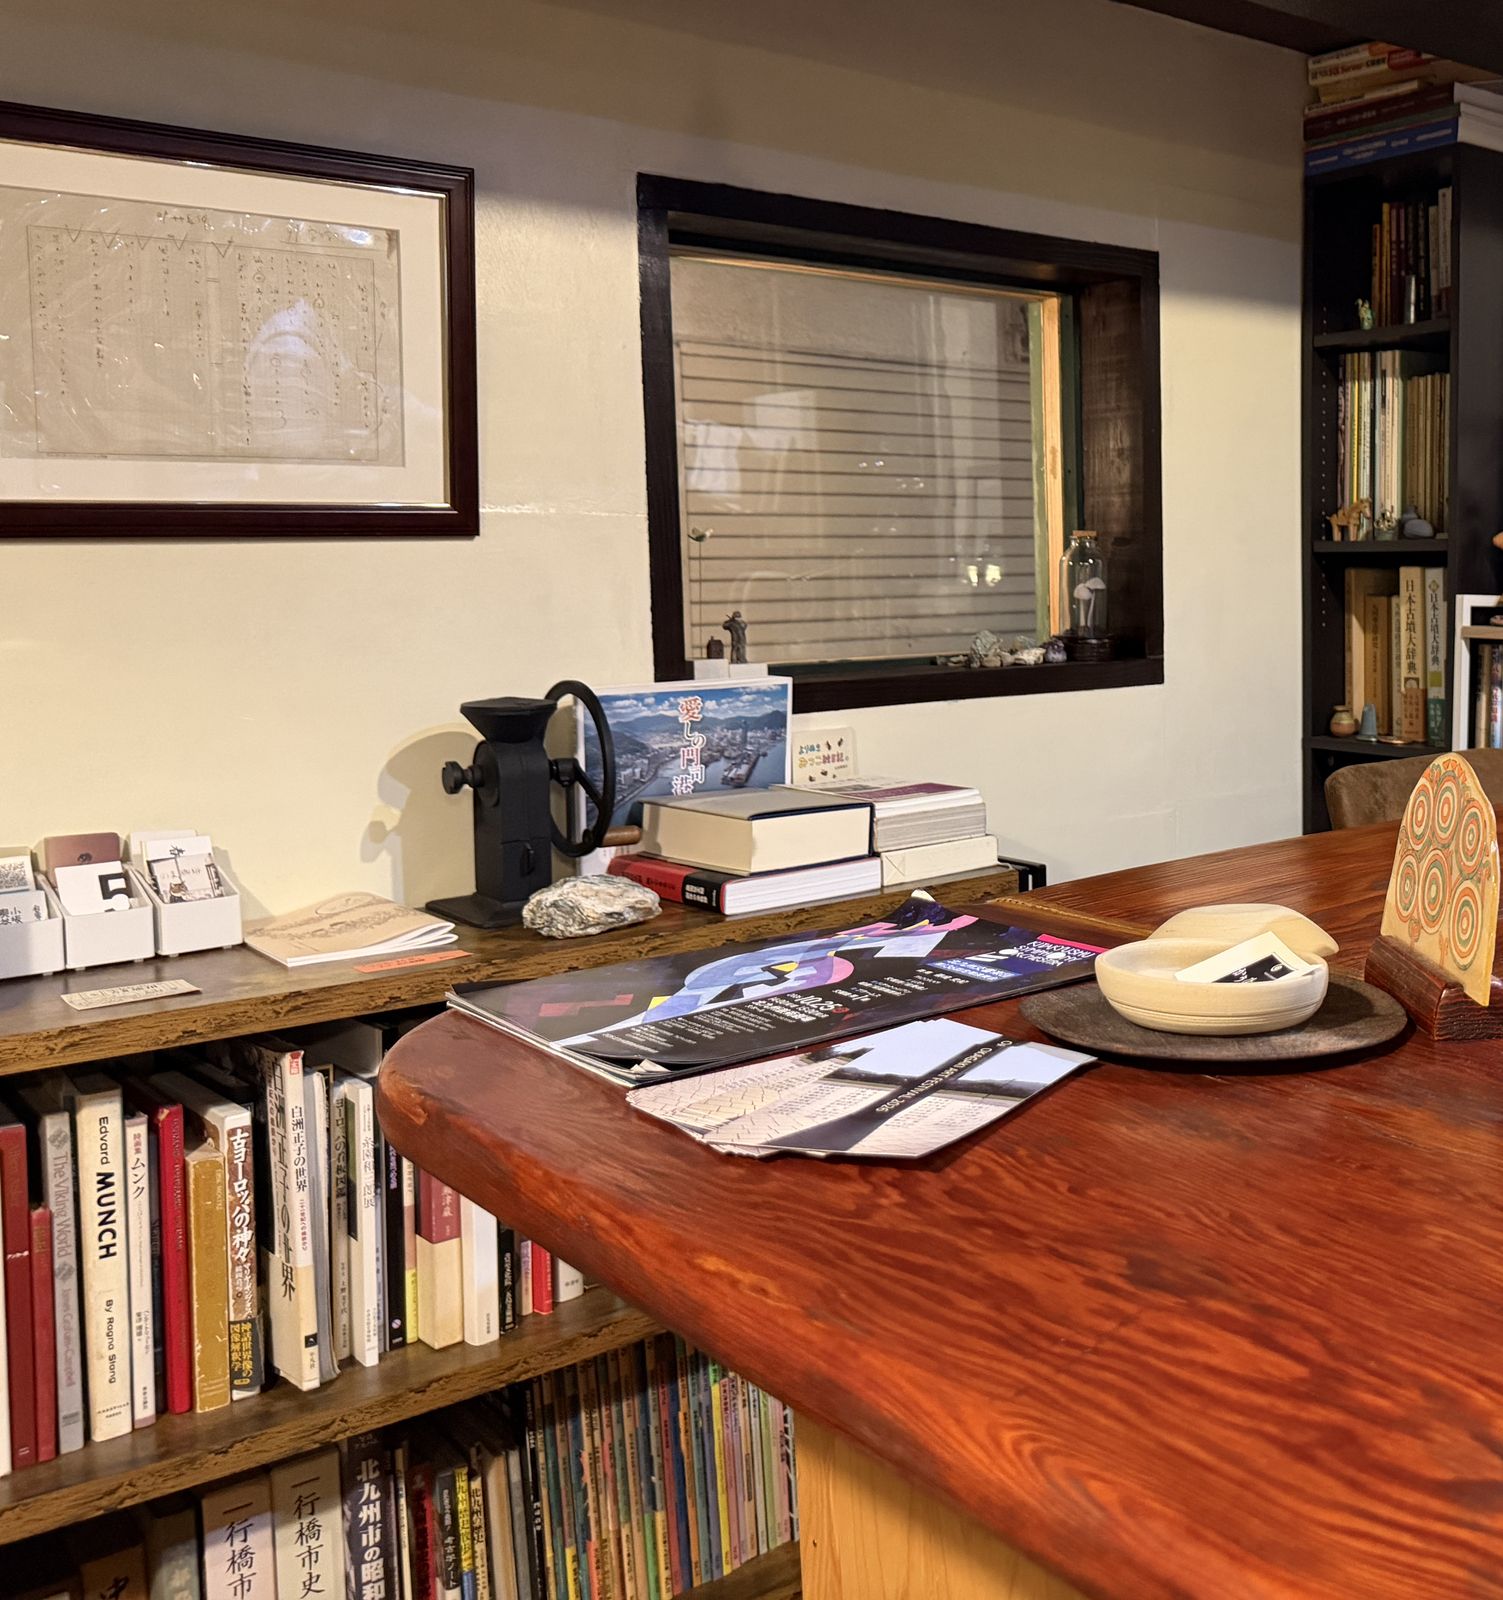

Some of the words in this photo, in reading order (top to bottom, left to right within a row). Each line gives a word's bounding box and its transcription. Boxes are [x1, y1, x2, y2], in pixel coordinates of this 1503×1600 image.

[1405, 579, 1417, 675] 日本古墳大辞典
[672, 695, 706, 796] 愛しの門司港
[900, 1076, 943, 1103] FESTIVAL
[940, 1065, 958, 1078] ART
[99, 1116, 111, 1165] Edvard
[291, 1105, 309, 1193] 白洲正子の世界
[53, 1151, 69, 1178] The
[131, 1158, 145, 1200] ムンク
[54, 1177, 71, 1218] Viking
[96, 1171, 117, 1260] MUNCH
[230, 1129, 252, 1264] 古ヨーロッパの神々
[56, 1217, 74, 1258] World
[104, 1299, 114, 1313] By
[106, 1316, 115, 1351] Ragna
[356, 1459, 386, 1600] 北九州市の昭和
